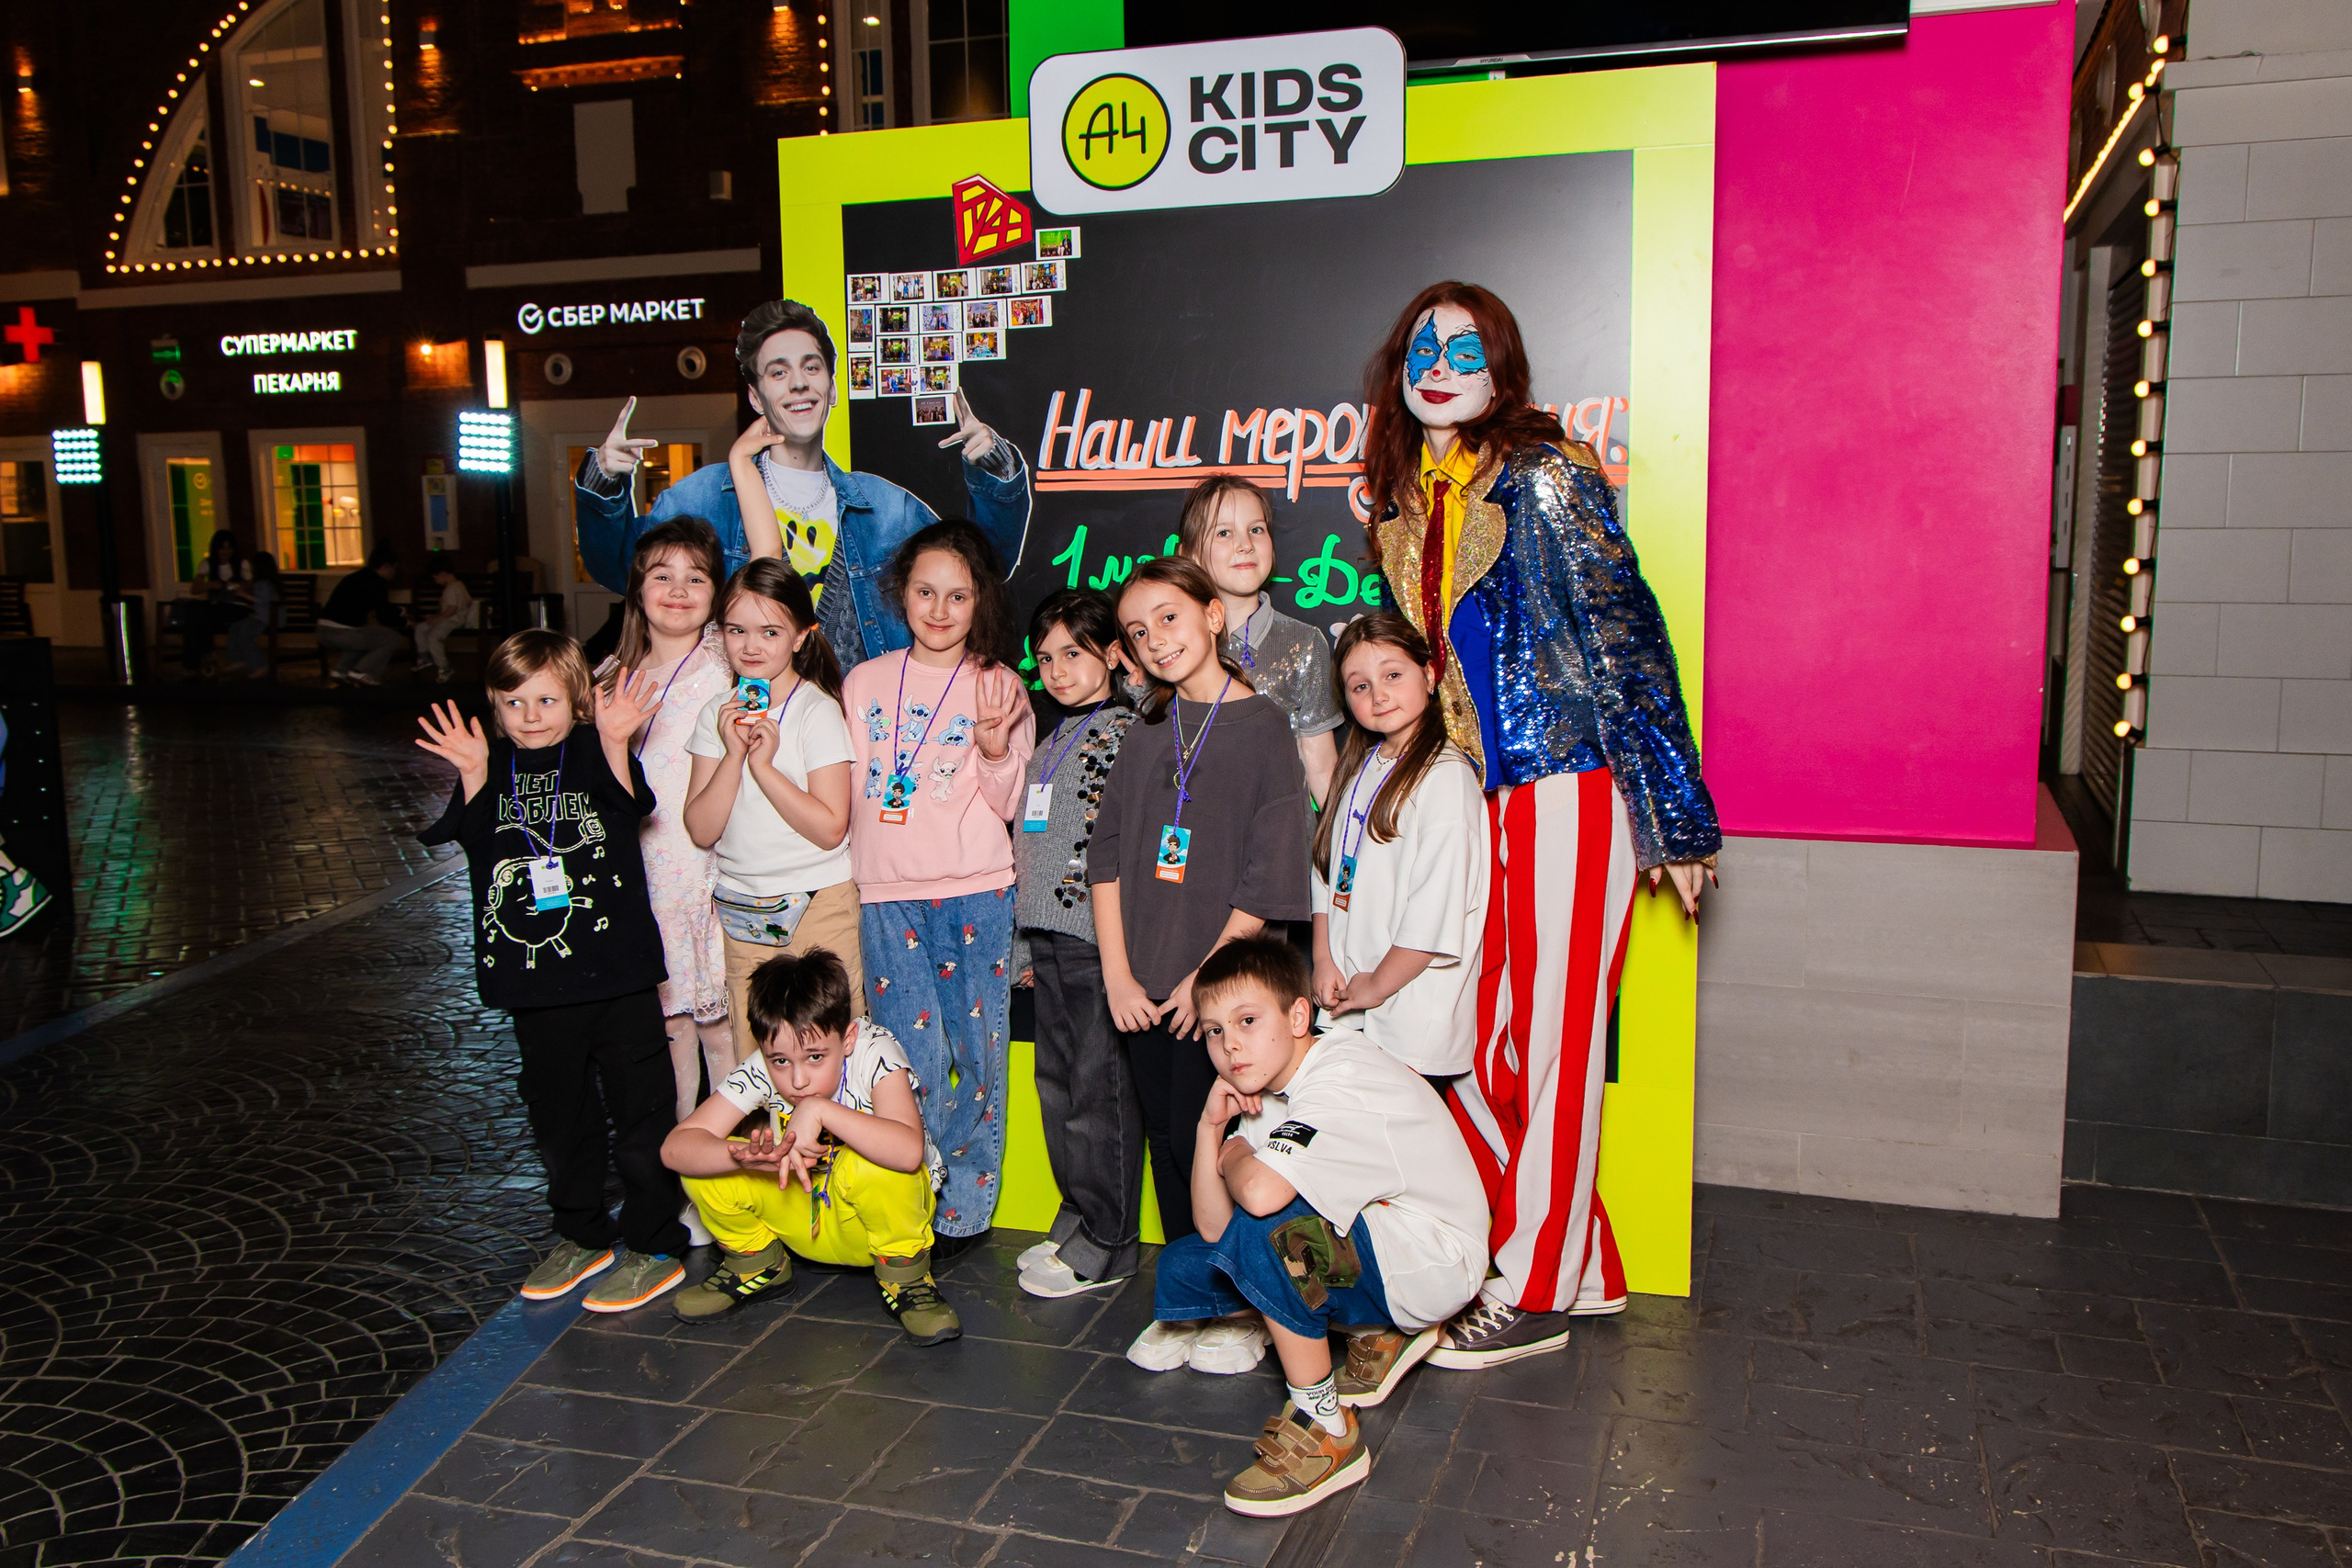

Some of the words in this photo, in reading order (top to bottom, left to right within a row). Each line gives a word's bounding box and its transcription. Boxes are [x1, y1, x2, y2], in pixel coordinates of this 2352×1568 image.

[1190, 63, 1363, 123] KIDS
[1079, 101, 1147, 161] A4
[1188, 116, 1367, 175] CITY
[548, 304, 606, 328] СБЕР
[609, 298, 706, 324] МАРКЕТ
[220, 329, 358, 356] СУПЕРМАРКЕТ
[253, 370, 342, 394] ПЕКАРНЯ
[1044, 388, 1203, 470] Наши
[512, 770, 560, 796] НЕТ
[1267, 1140, 1293, 1155] VSLV4
